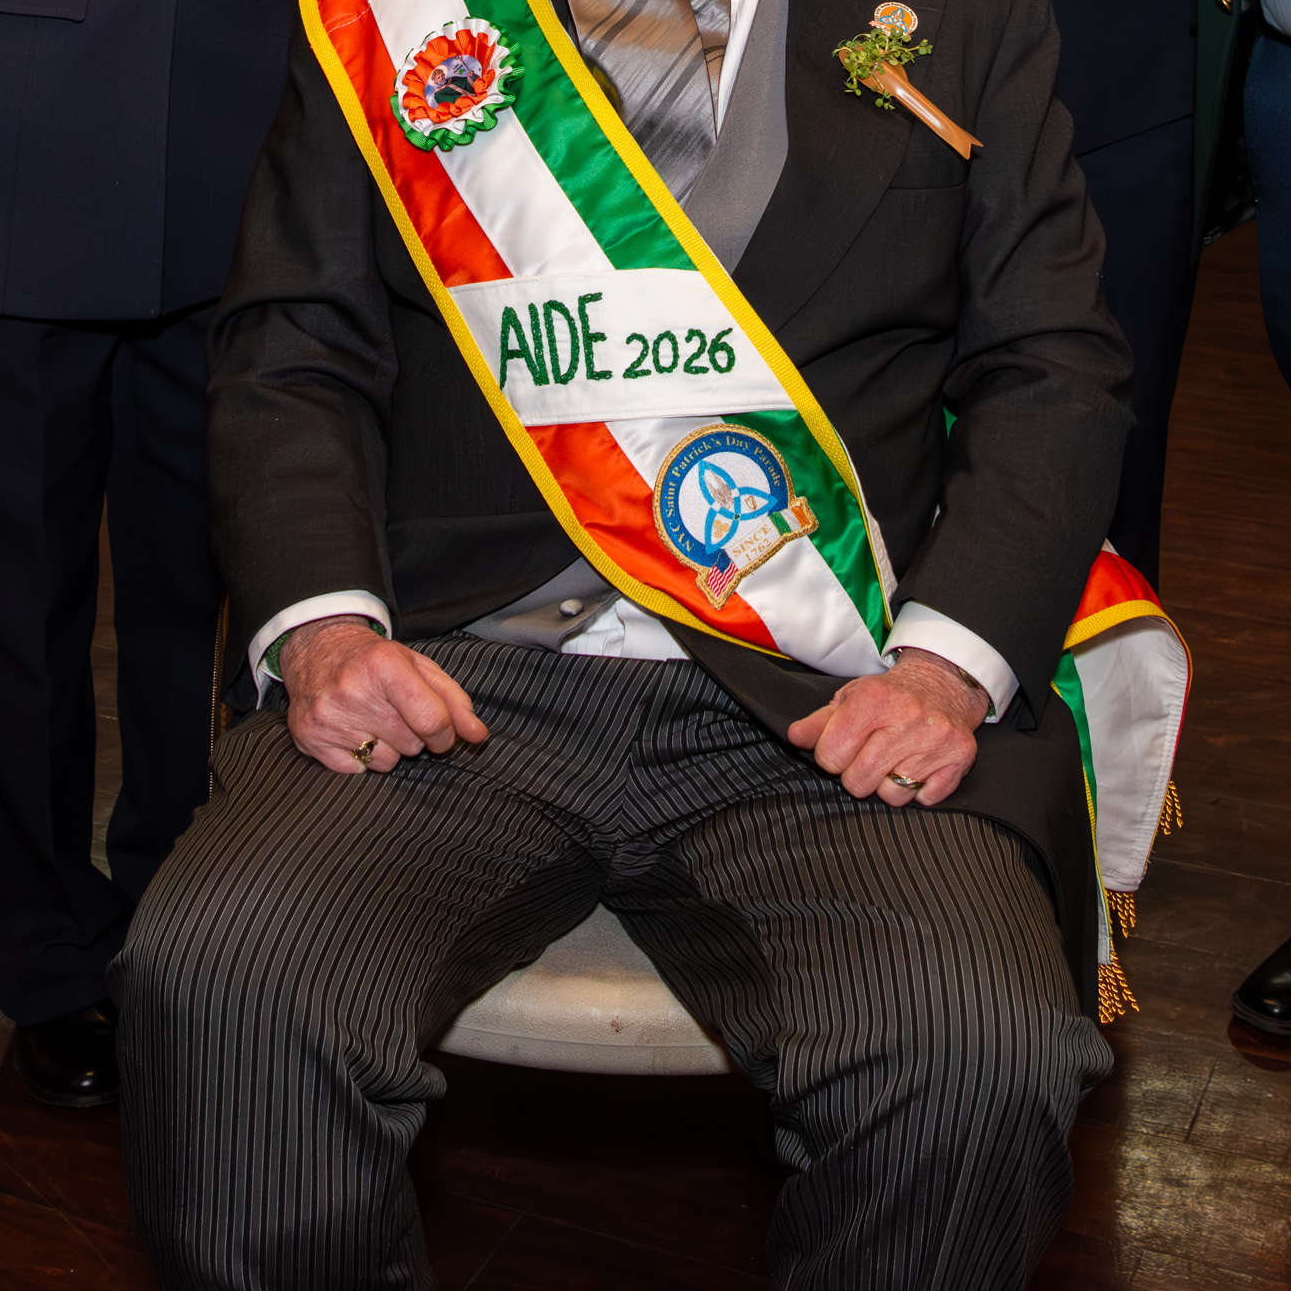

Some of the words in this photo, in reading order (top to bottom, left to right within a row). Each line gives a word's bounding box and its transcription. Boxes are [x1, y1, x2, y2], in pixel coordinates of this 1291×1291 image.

[499, 291, 613, 391] AIDE
[622, 327, 737, 380] 2026
[672, 437, 722, 477] Patrick's
[725, 435, 751, 450] Day
[752, 446, 781, 488] Parade
[664, 482, 677, 518] Saint
[668, 521, 695, 553] NYC
[732, 523, 772, 559] SINCE
[744, 537, 772, 563] 1762
